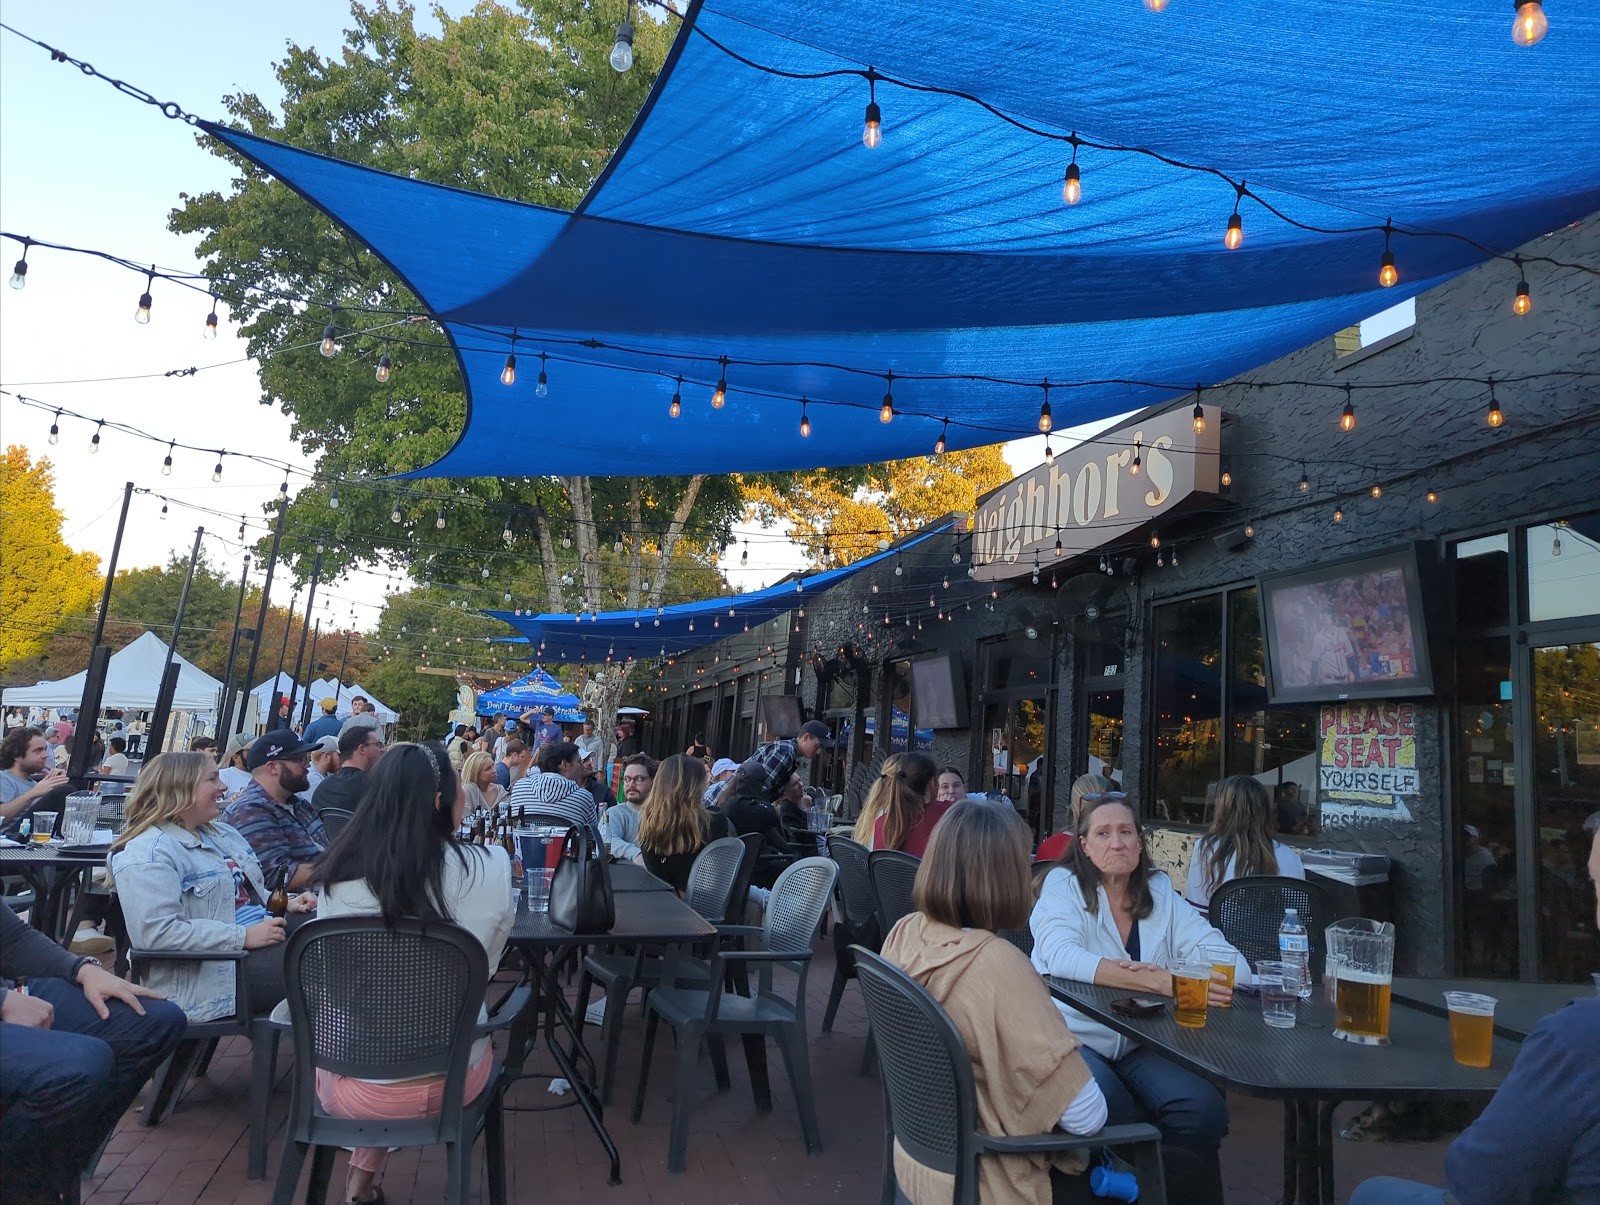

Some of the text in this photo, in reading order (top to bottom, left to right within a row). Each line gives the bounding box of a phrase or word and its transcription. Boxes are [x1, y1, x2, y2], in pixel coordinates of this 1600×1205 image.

[974, 430, 1174, 572] Neighbor's
[1321, 704, 1415, 737] PLEASE
[1334, 738, 1401, 769] SEAT
